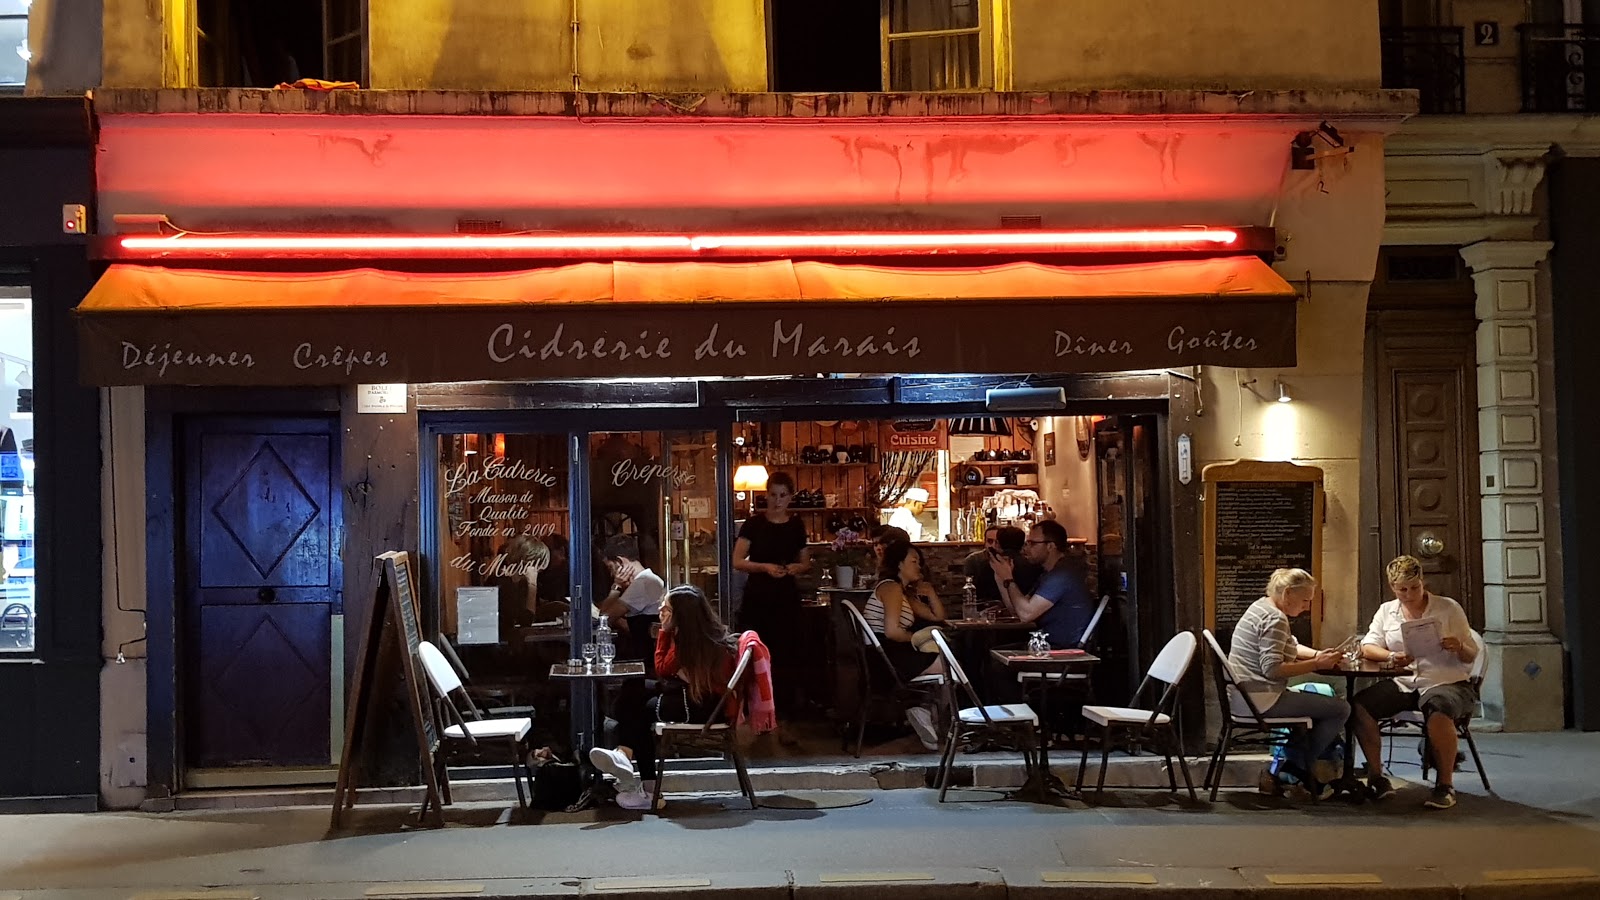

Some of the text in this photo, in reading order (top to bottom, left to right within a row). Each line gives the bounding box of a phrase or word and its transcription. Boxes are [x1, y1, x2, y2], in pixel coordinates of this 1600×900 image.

[1480, 23, 1493, 45] 2
[487, 319, 921, 363] Cidrerie du Marais
[1055, 325, 1258, 357] Dîner Goûter
[121, 341, 389, 377] Déjeuner Crêpes
[890, 434, 937, 446] Cuisine
[444, 454, 557, 498] La Cidrerie
[469, 486, 534, 504] Maison de
[479, 504, 530, 523] Qualité
[456, 520, 556, 538] Fondée en 2009
[450, 552, 550, 578] du Marais
